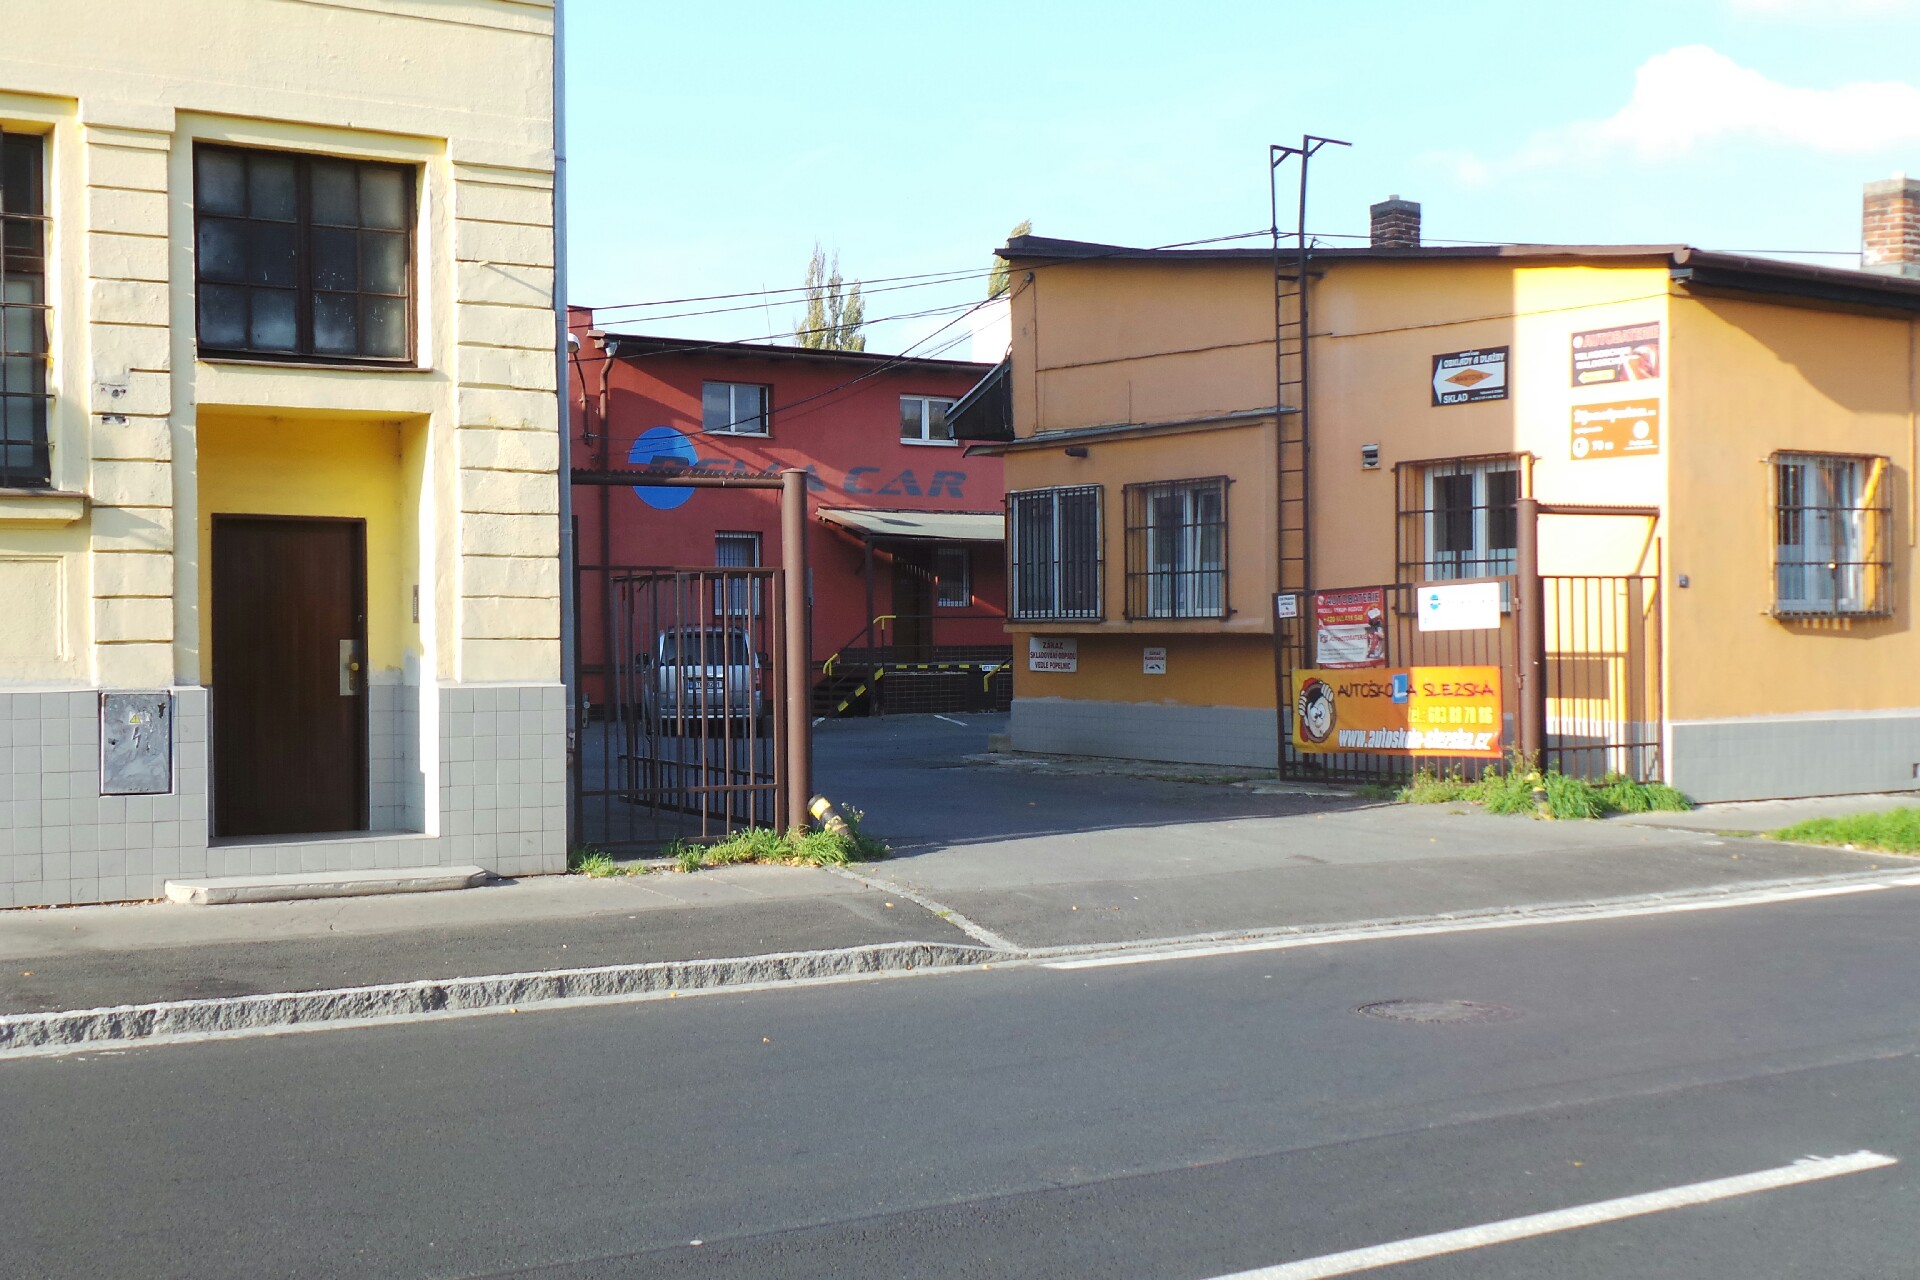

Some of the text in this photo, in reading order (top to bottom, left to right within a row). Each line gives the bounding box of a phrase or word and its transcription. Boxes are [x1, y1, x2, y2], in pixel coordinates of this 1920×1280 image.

[1443, 393, 1468, 404] SKLAD
[842, 466, 967, 498] CAR
[1327, 592, 1380, 605] AUTOBATERIE
[1338, 679, 1418, 698] AUTOŠKOLA
